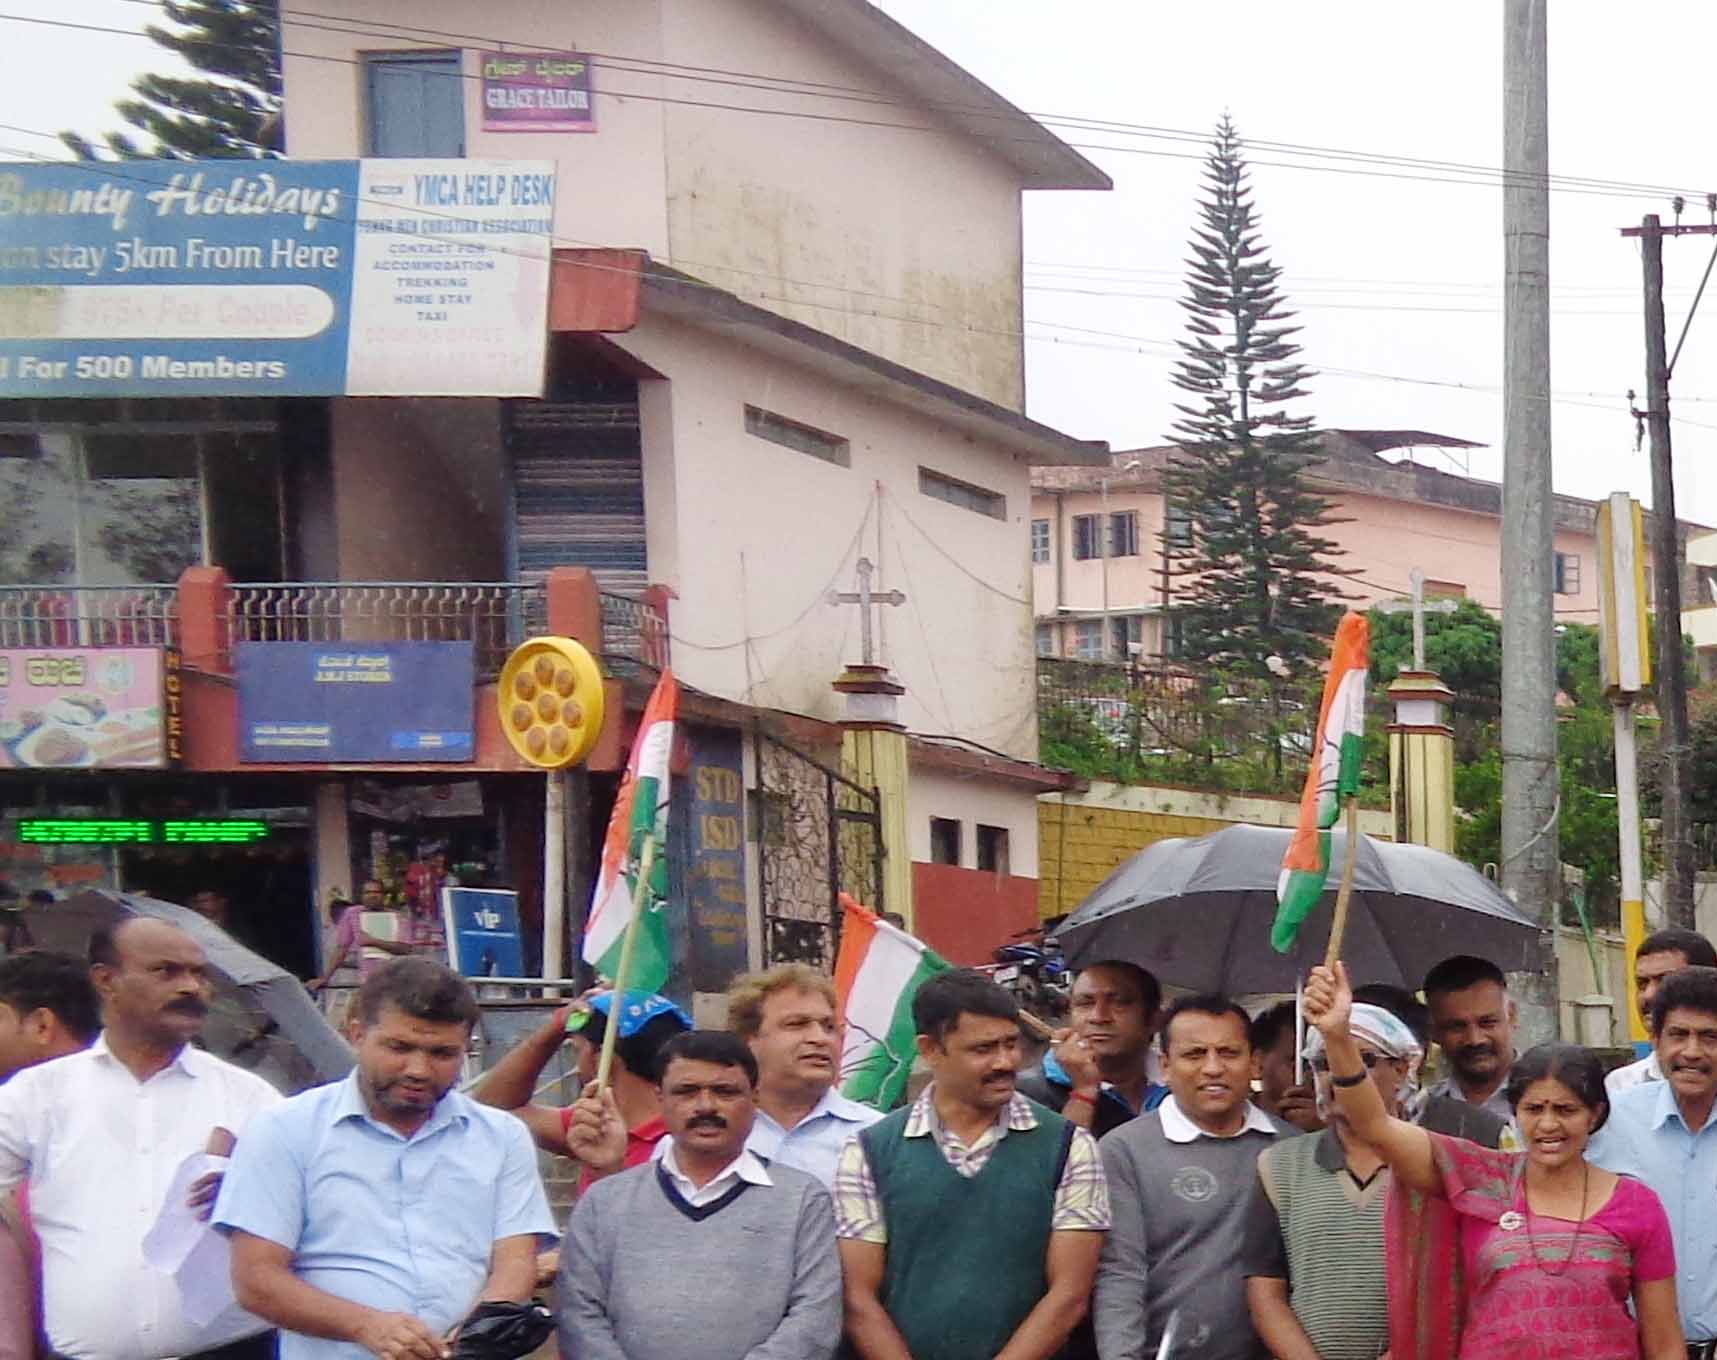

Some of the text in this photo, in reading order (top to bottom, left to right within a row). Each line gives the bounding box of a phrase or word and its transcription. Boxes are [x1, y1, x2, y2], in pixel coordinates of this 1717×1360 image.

[414, 174, 552, 206] YMCA HELP DESK
[145, 172, 341, 232] Holidays
[388, 243, 452, 254] CONTACT
[46, 244, 107, 276] stay
[113, 238, 177, 273] 5km
[187, 238, 261, 269] From
[270, 238, 339, 270] Here
[372, 260, 496, 271] ACCOMMODATION
[396, 277, 468, 288] TREKKING
[394, 294, 472, 305] HOME STAY
[416, 311, 448, 322] TAXI
[18, 357, 69, 379] For
[75, 356, 134, 379] 500
[141, 355, 288, 379] Members
